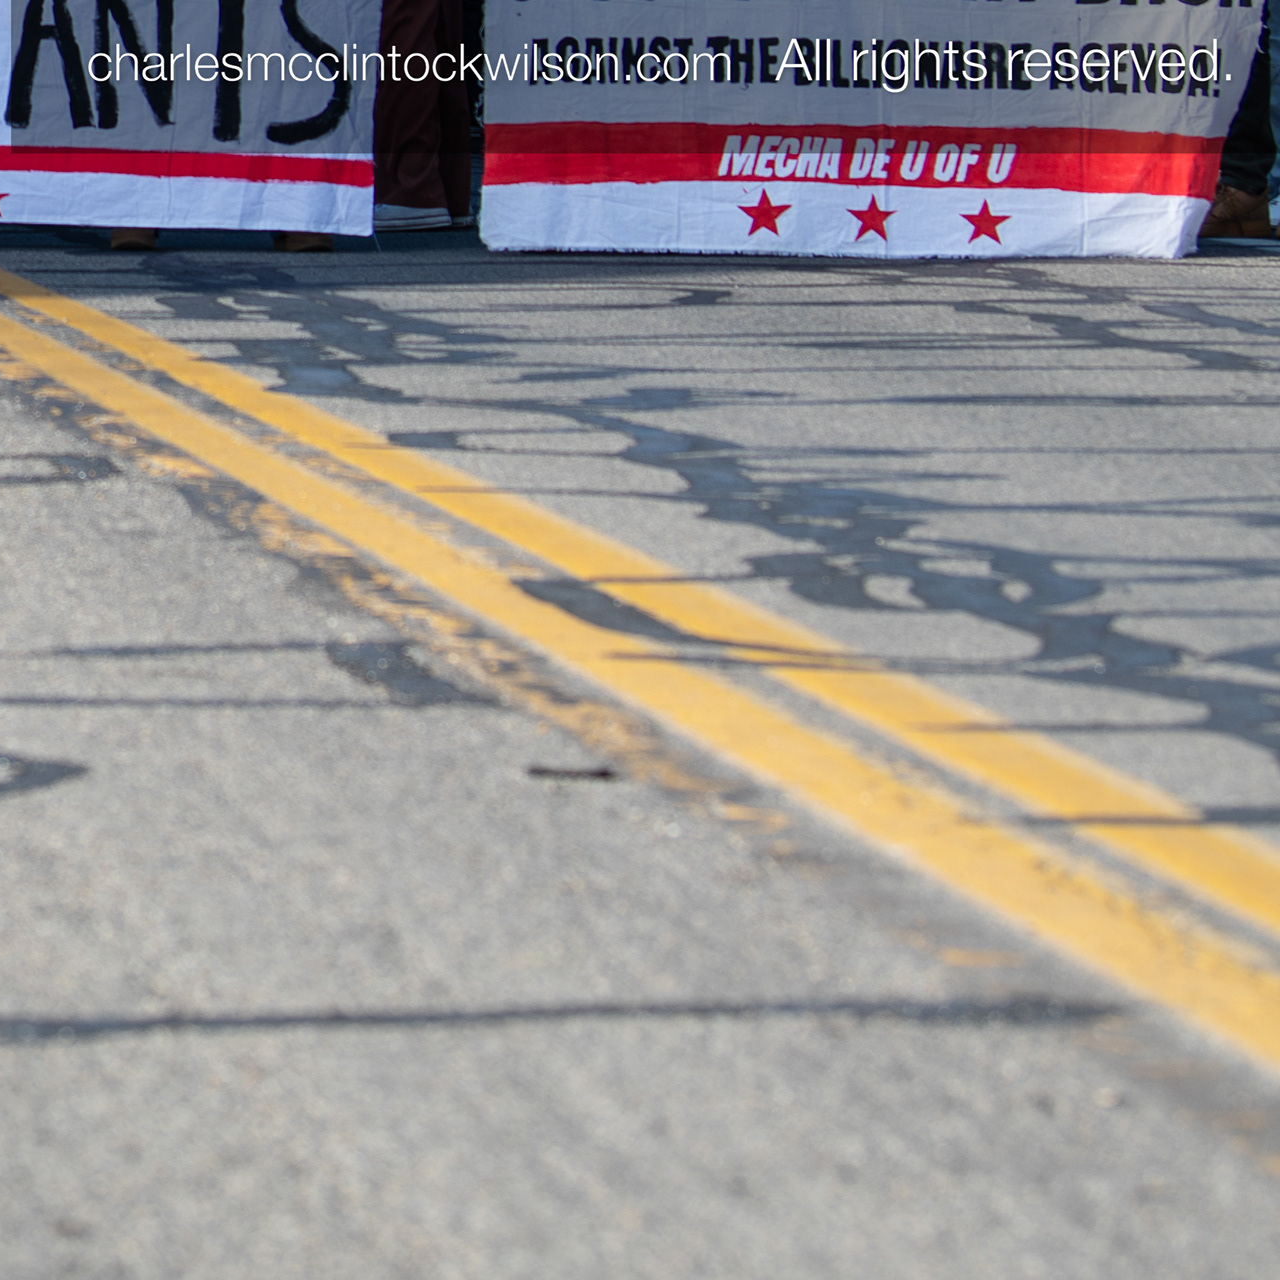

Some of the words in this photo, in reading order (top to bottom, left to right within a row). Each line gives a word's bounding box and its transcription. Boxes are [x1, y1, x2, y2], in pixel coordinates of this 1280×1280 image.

[530, 36, 693, 86] AGAINST
[706, 35, 780, 85] THE
[794, 37, 1033, 91] BILLIONAIRE
[1049, 41, 1222, 98] AGENDA!
[718, 135, 844, 180] MECHA
[849, 138, 896, 180] DE
[900, 140, 930, 181] U
[933, 143, 982, 184] OF
[986, 143, 1018, 184] U
